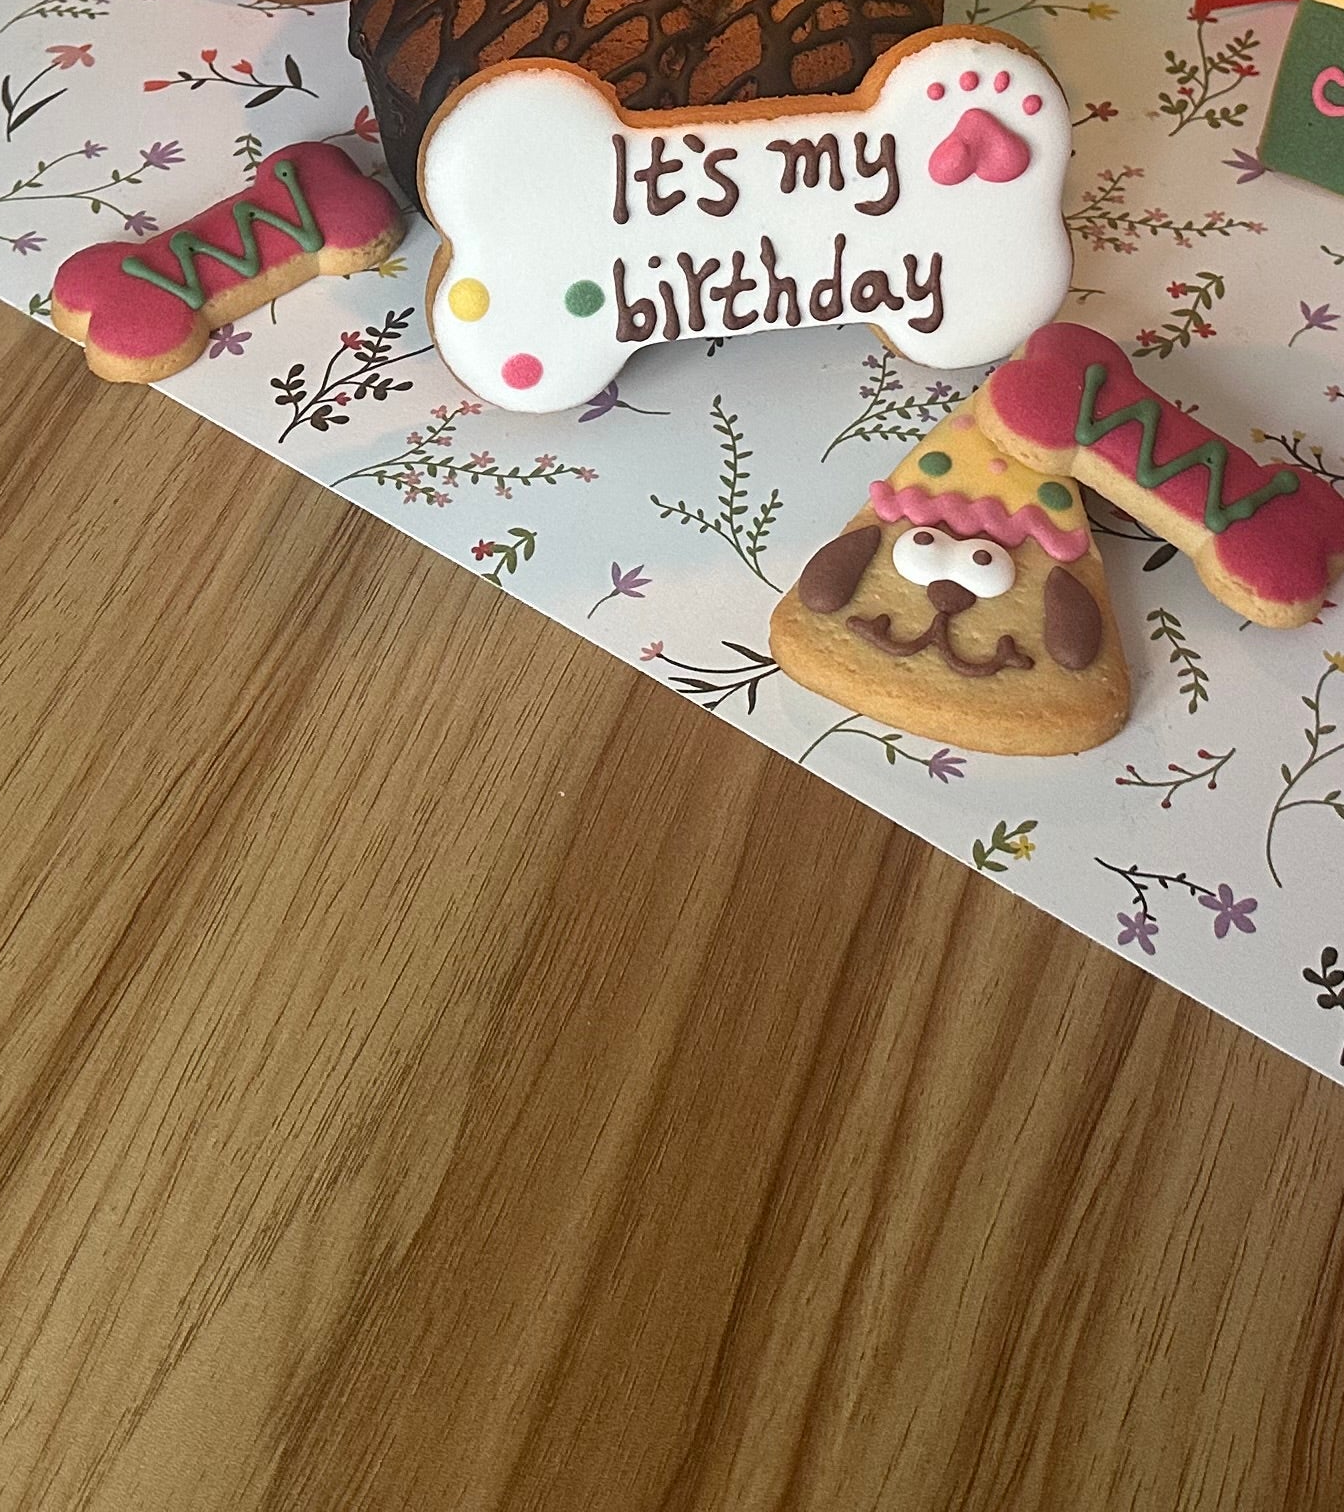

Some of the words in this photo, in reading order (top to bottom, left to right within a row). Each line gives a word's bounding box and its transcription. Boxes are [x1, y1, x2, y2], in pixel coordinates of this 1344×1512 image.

[611, 132, 740, 226] It's
[765, 131, 901, 217] my
[613, 232, 945, 343] birthday
